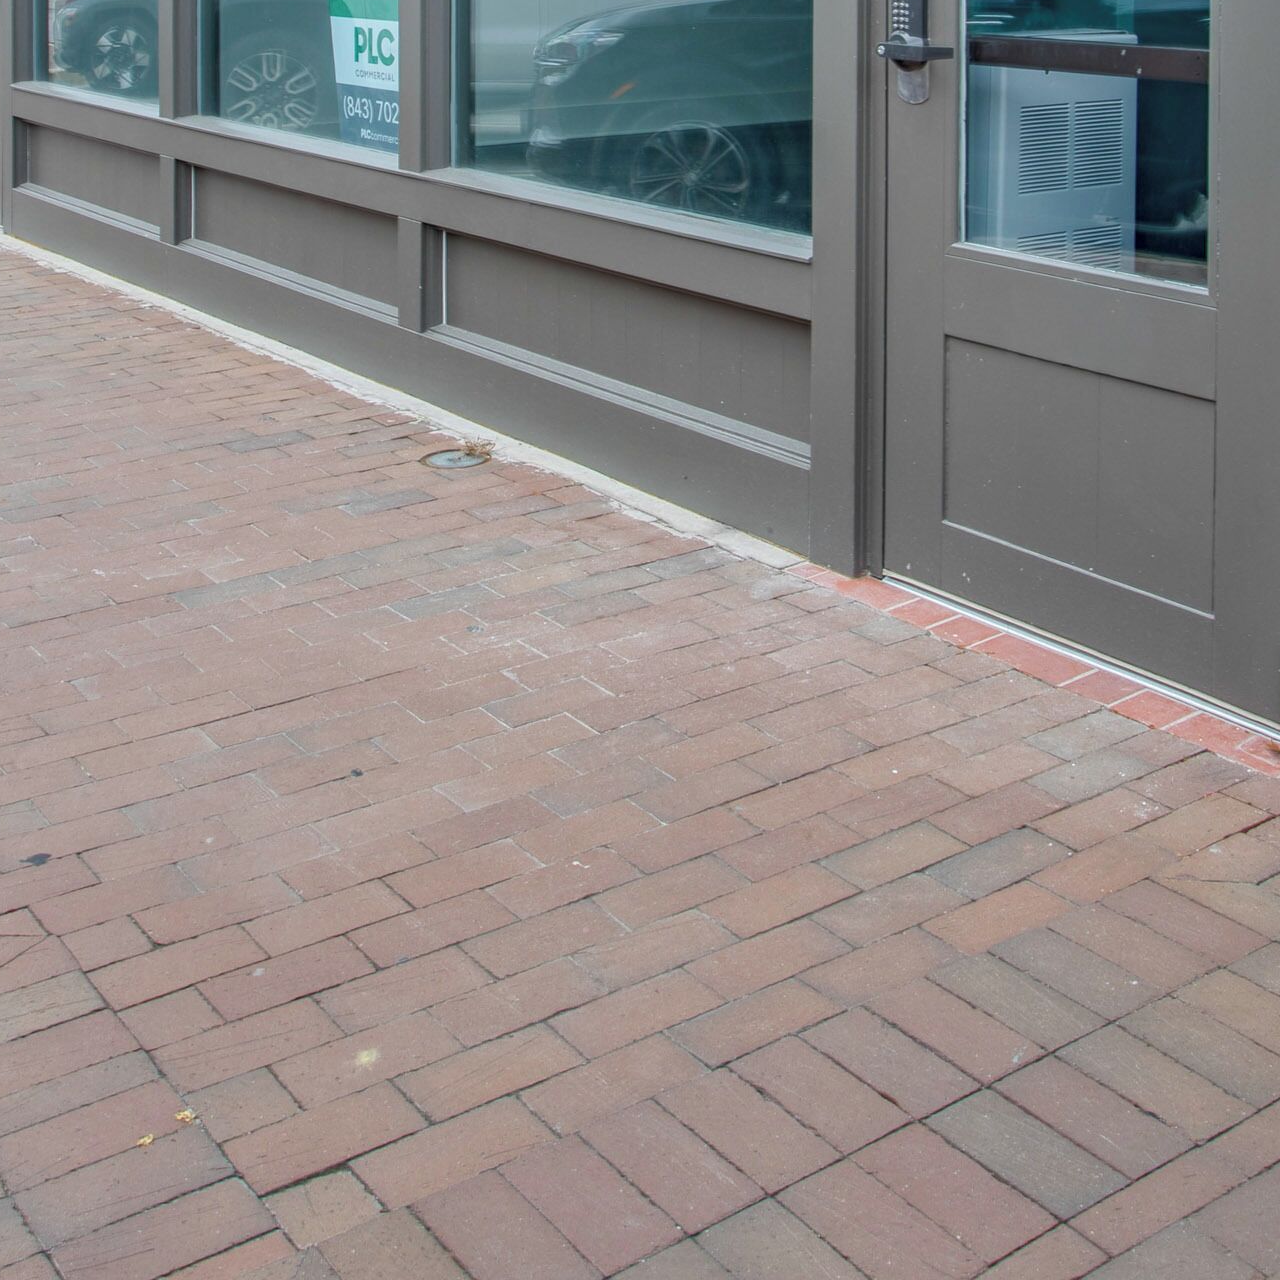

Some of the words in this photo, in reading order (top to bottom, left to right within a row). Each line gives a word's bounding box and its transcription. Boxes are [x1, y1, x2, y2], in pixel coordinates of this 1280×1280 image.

[354, 26, 395, 67] PLC
[355, 69, 395, 81] COMMERCIAL
[343, 95, 373, 123] (843)
[376, 100, 399, 124] 702
